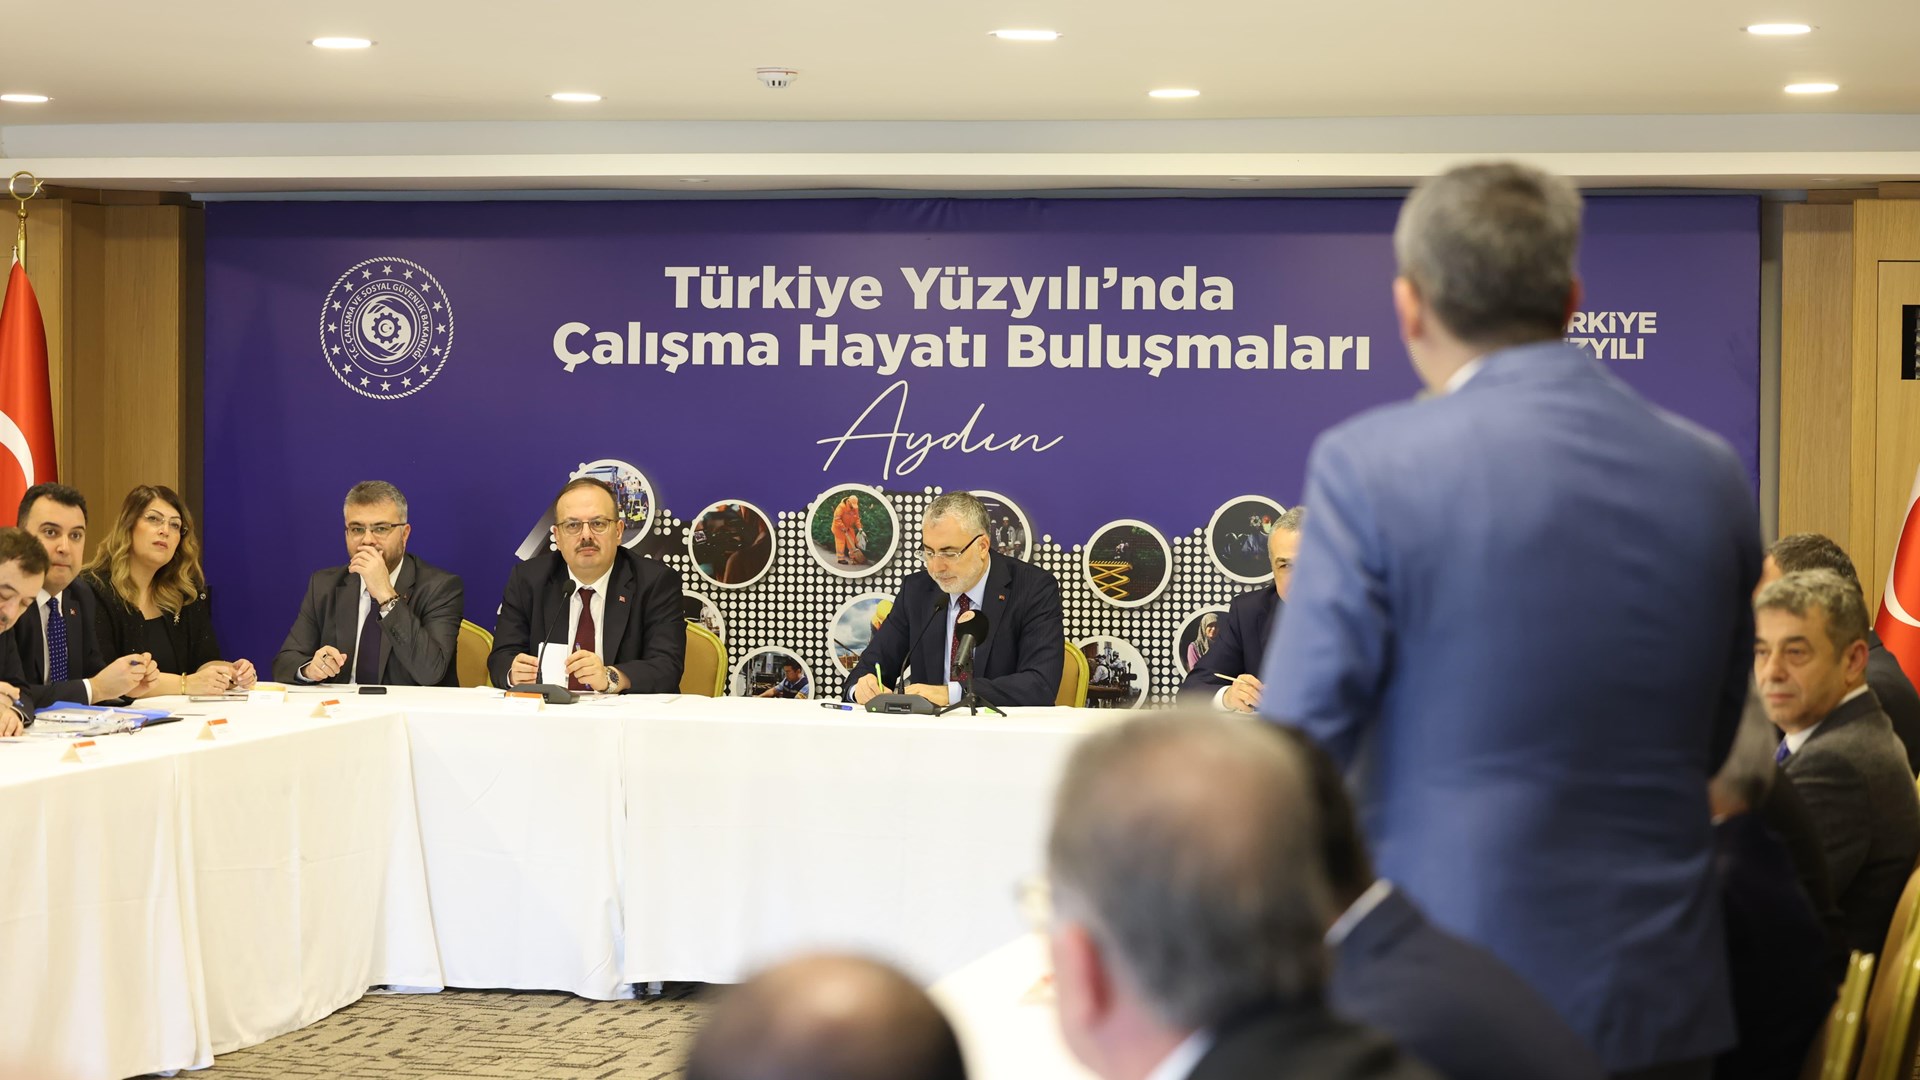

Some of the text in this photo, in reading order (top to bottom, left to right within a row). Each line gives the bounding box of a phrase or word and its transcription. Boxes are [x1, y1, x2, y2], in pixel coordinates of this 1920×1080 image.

[664, 265, 883, 318] Türkiye
[344, 306, 356, 344] ÇALIŞMA
[352, 294, 363, 306] VE
[361, 282, 391, 298] SOSYAL
[392, 283, 427, 314] GÜVENLİK
[411, 313, 430, 360] BAKANLIĞI
[1563, 337, 1645, 360] YILI
[1566, 311, 1657, 334] RKİYE
[553, 321, 1370, 378] Çalışma Hayatı Buluşmaları
[816, 380, 1064, 480] Aydın
